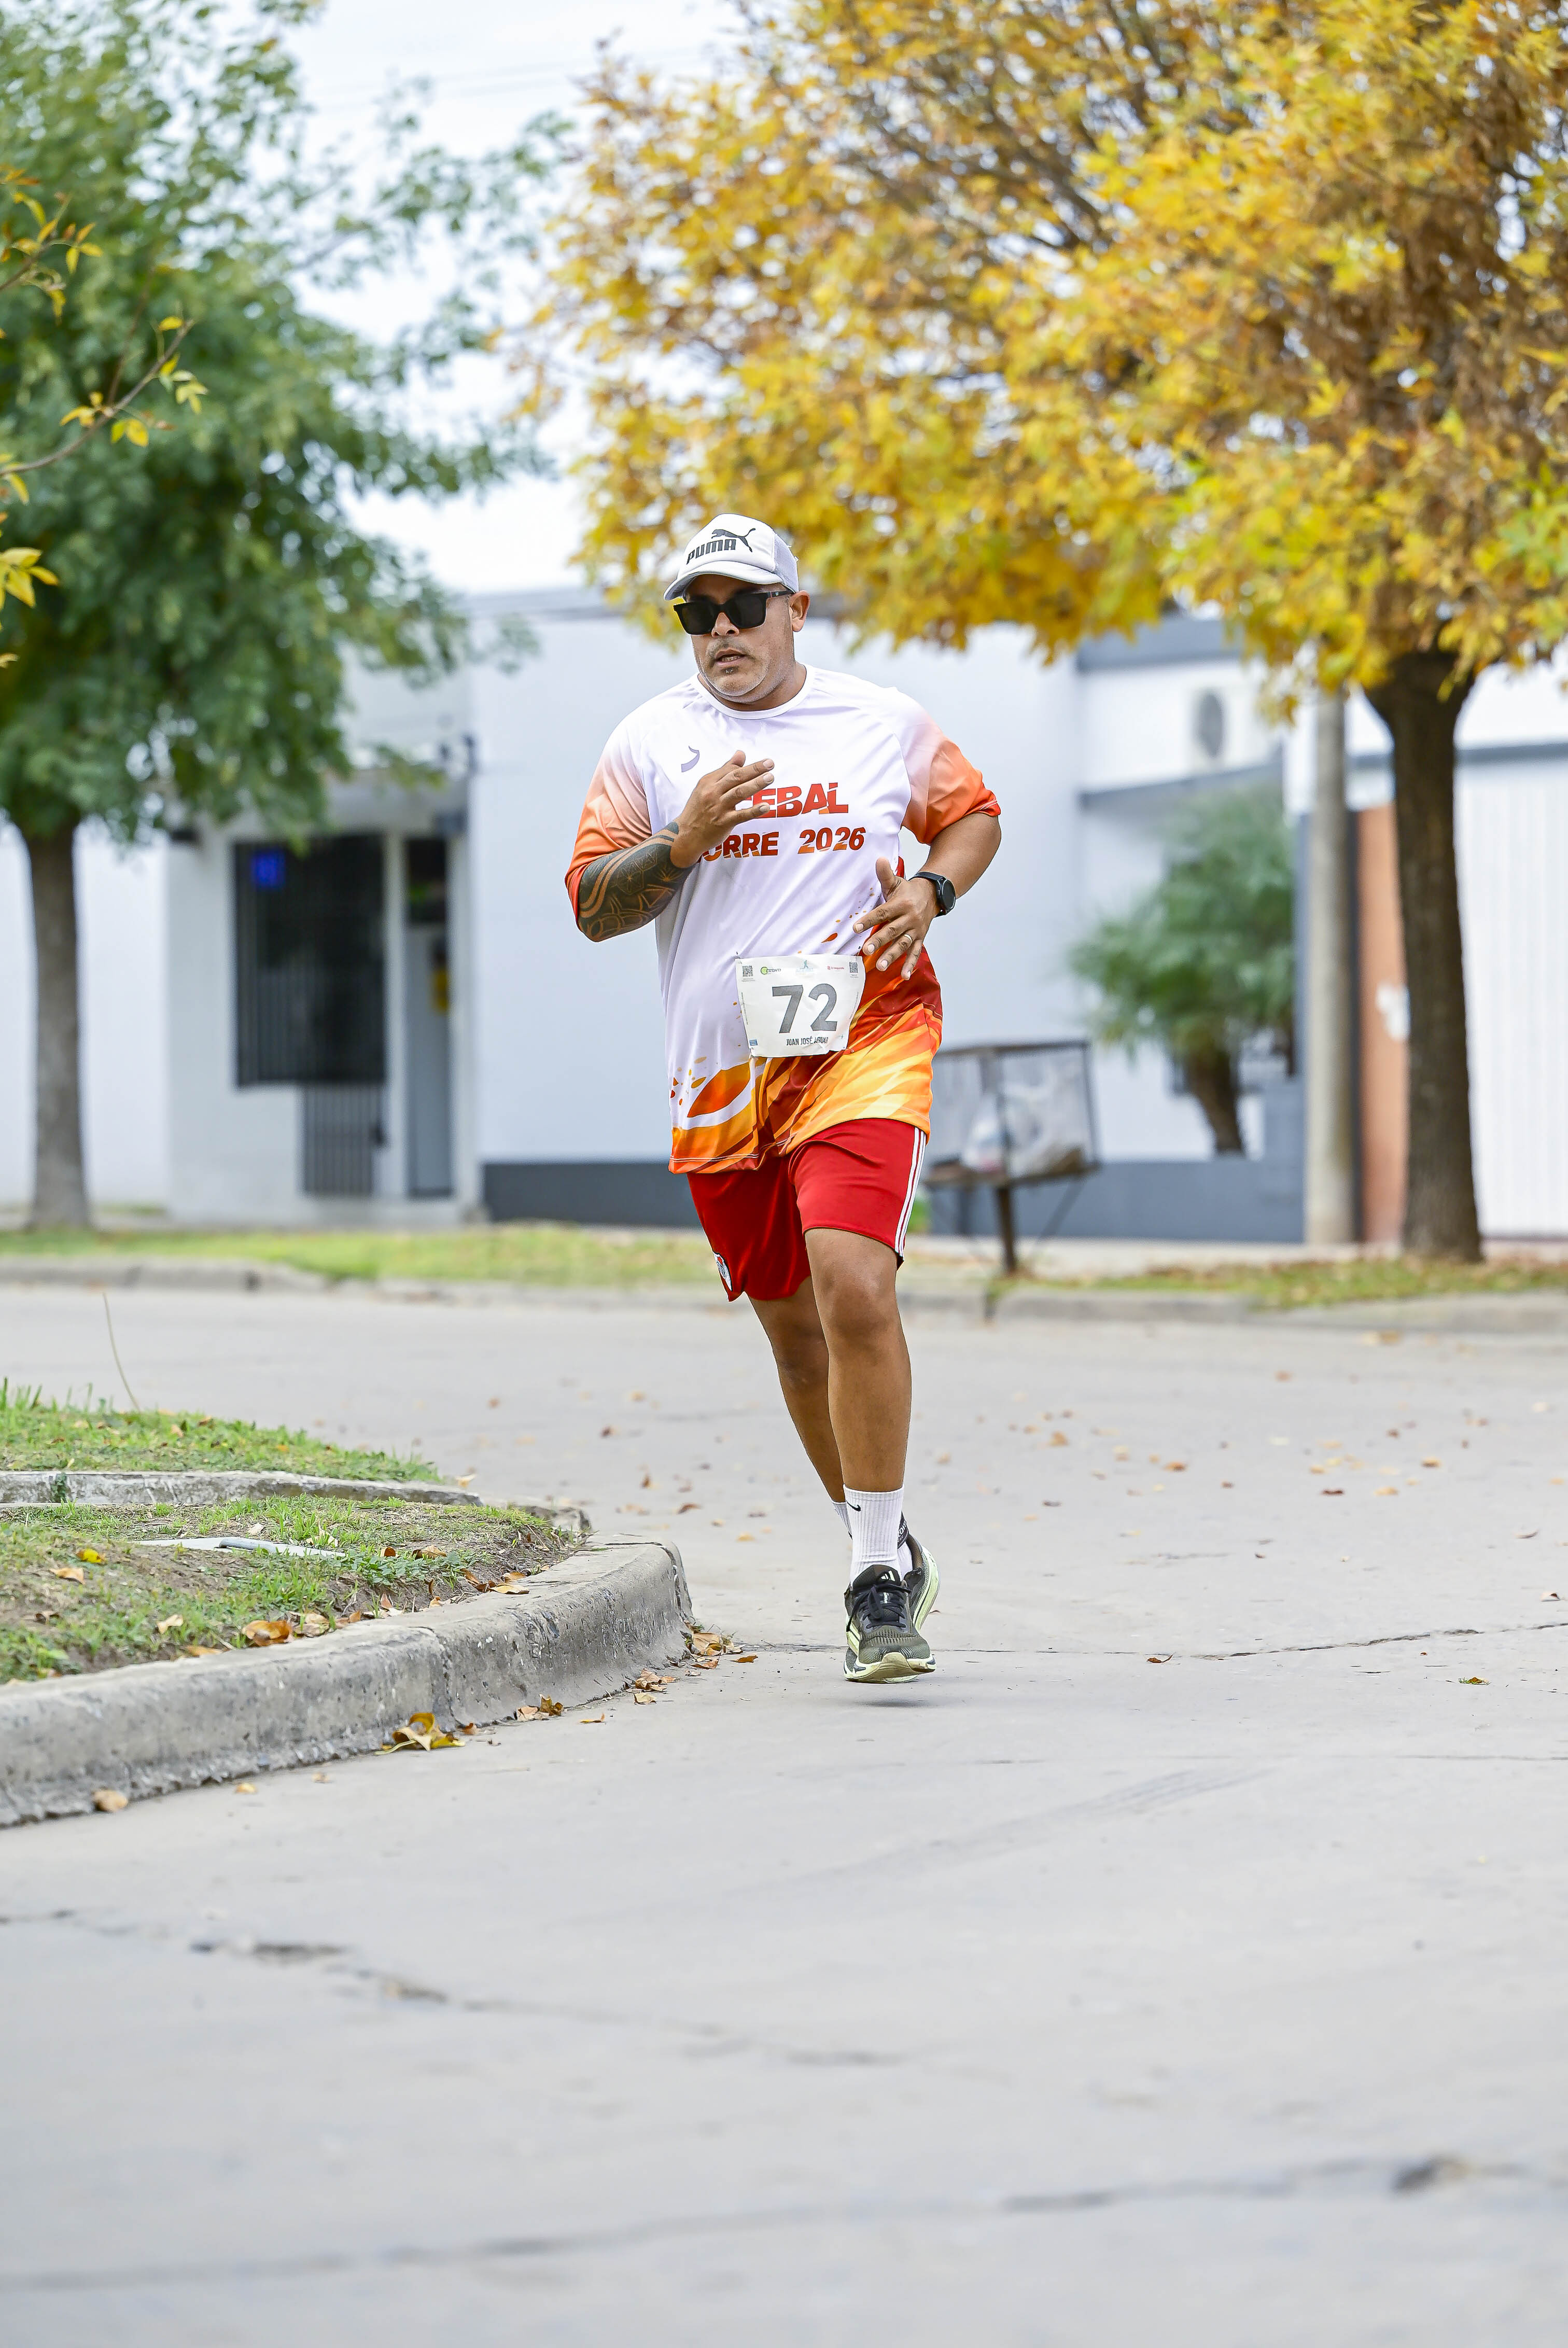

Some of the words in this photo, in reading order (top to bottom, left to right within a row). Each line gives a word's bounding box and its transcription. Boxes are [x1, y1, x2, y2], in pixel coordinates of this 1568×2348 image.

[686, 539, 736, 565] PUMA
[747, 782, 849, 818] EBAL
[797, 827, 866, 854] 2026
[772, 983, 837, 1033] 72
[801, 1036, 814, 1045] JOSÉ
